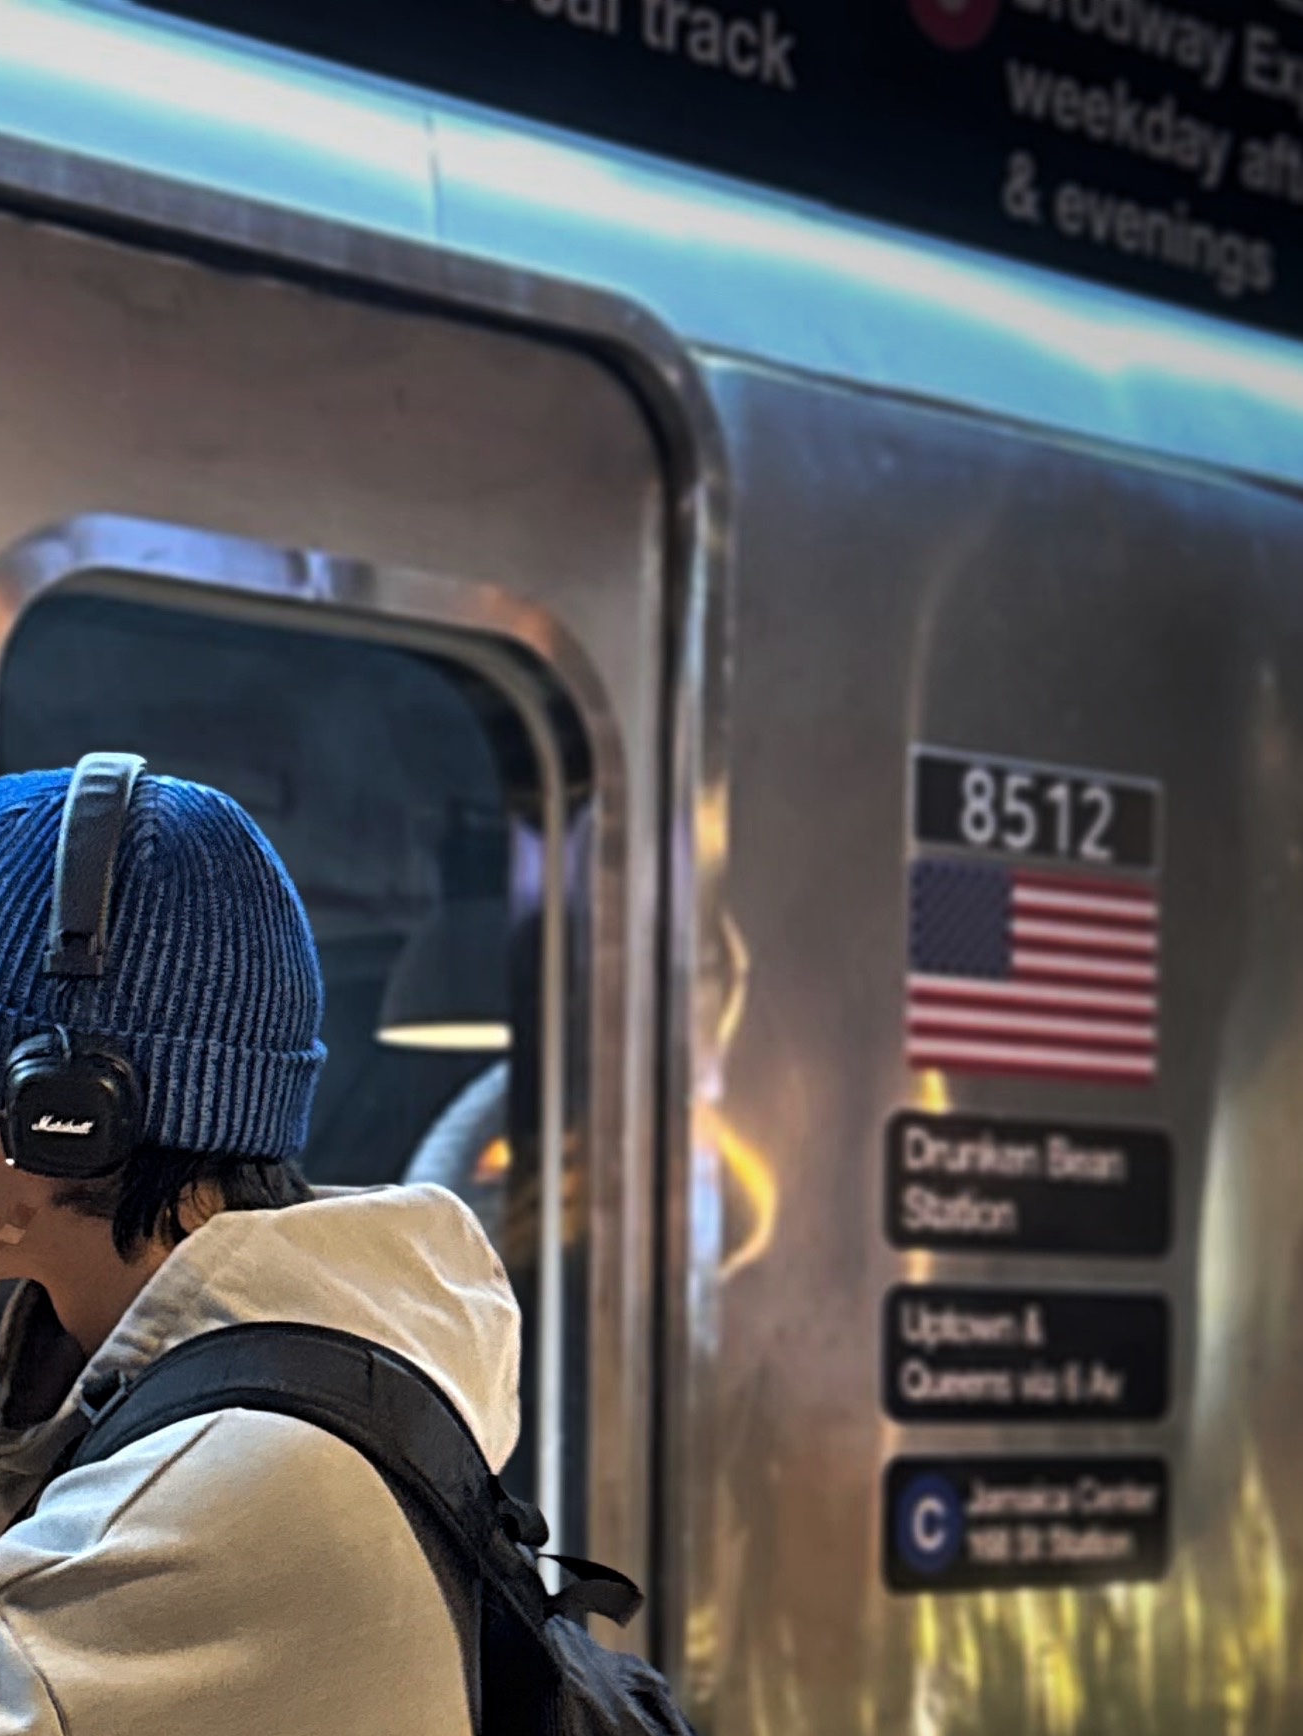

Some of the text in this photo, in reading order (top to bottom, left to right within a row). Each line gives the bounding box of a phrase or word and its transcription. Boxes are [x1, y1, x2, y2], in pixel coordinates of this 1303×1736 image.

[640, 0, 796, 92] track
[1004, 58, 1233, 190] weekday
[1003, 150, 1274, 296] & evenings
[961, 768, 1114, 861] 8512
[903, 1127, 1039, 1177] Drunken
[902, 1185, 1016, 1233] Station
[901, 1302, 1016, 1352] Uptown
[901, 1358, 1013, 1402] Queens
[912, 1496, 946, 1551] C
